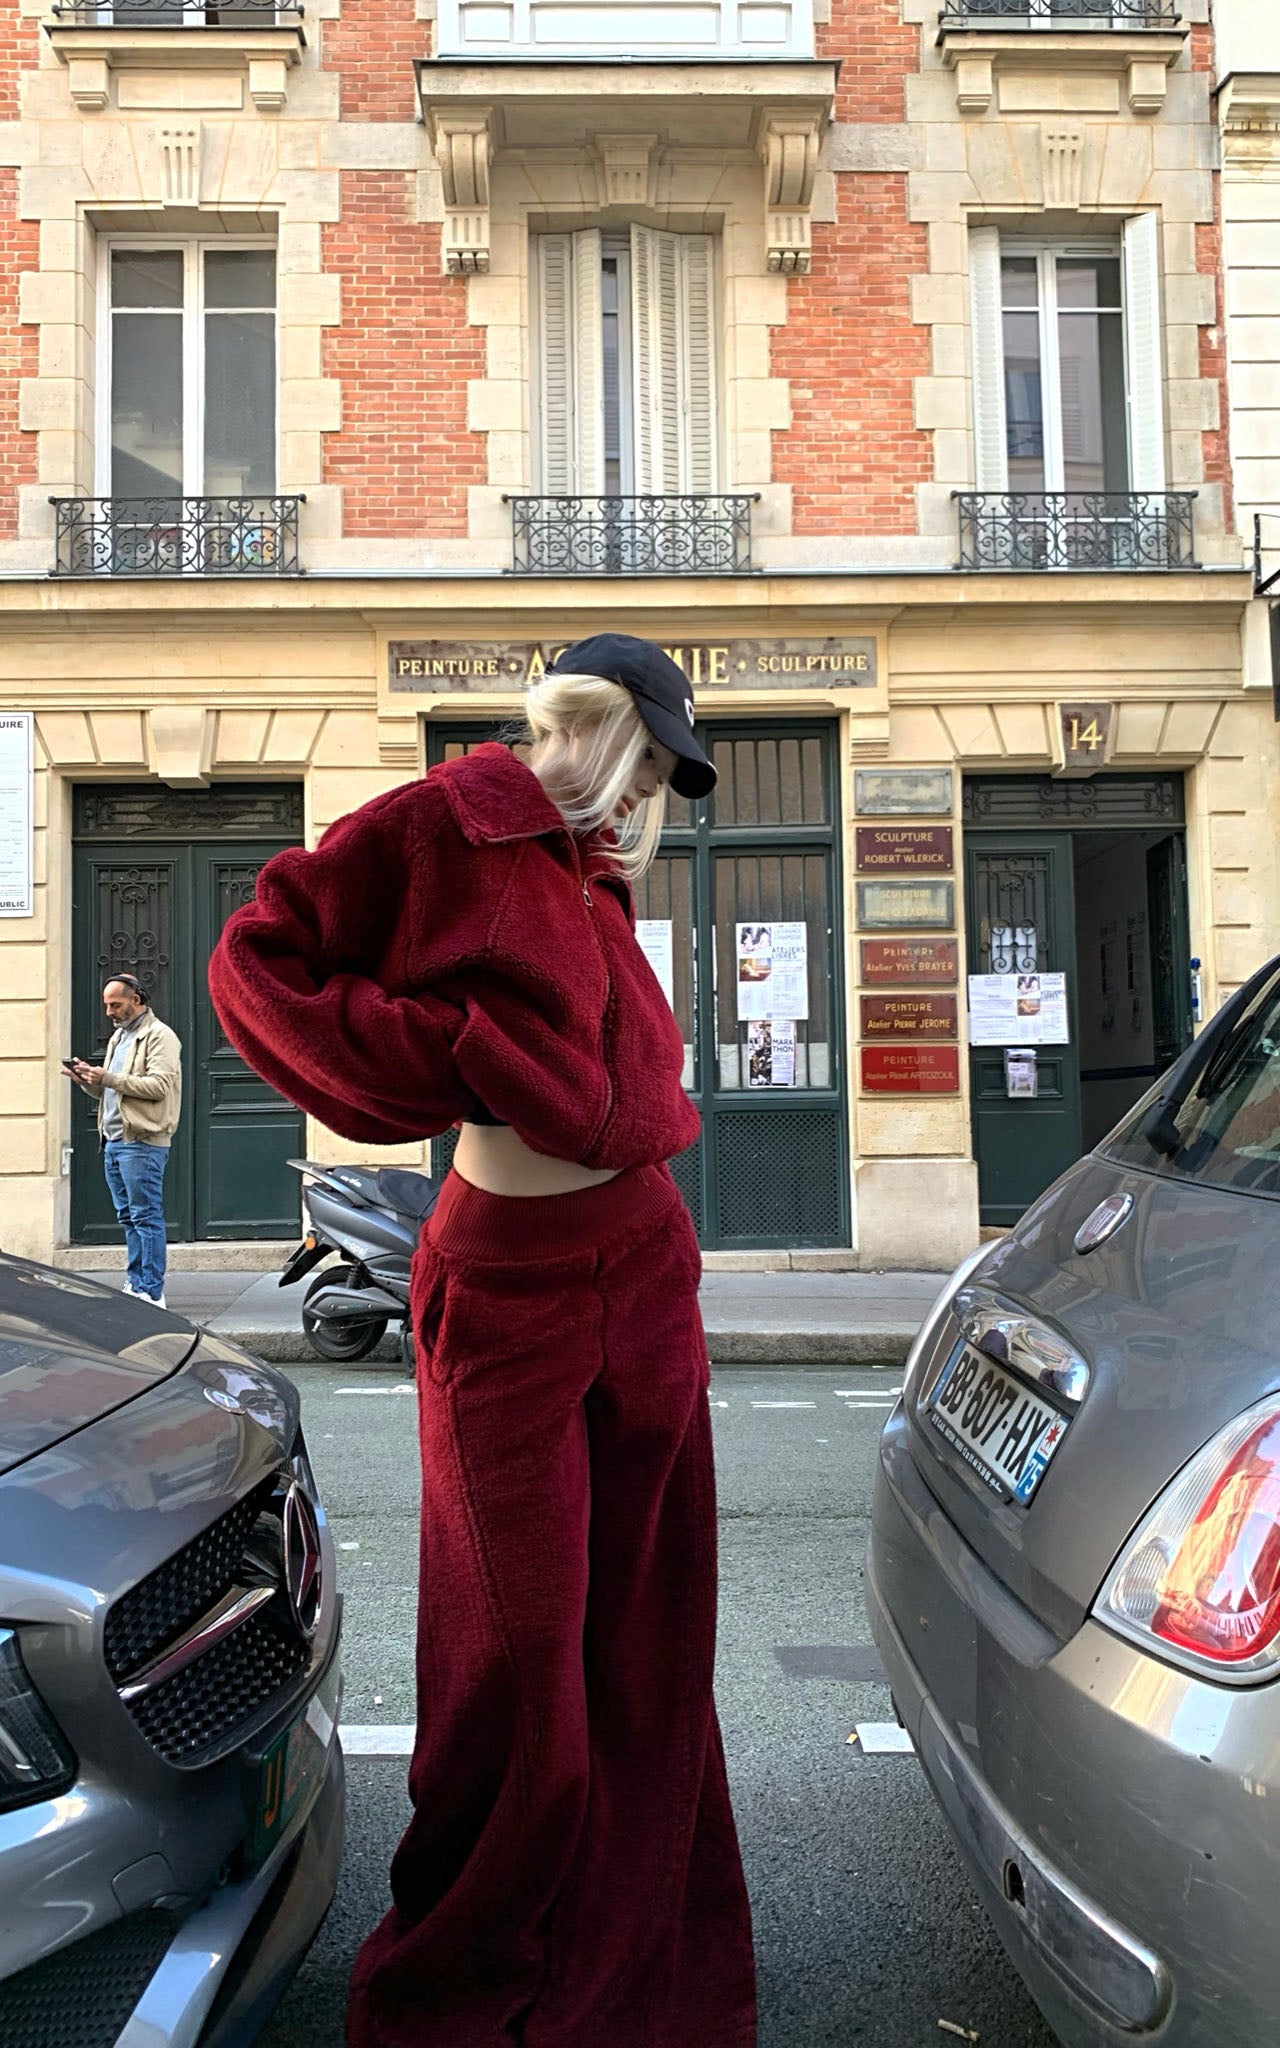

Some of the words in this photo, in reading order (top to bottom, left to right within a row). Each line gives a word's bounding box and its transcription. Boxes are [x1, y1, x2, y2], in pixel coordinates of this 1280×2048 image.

[399, 659, 498, 676] PEINTURE
[757, 655, 867, 672] SCULPTURE
[1070, 718, 1102, 750] 14
[874, 832, 934, 843] SCULPTURE
[864, 854, 900, 864] ROBERT
[903, 853, 944, 863] WLERICK
[866, 963, 893, 972] Atelier
[884, 1003, 933, 1012] PEINTURE
[867, 1020, 891, 1029] Atelier
[883, 1055, 935, 1065] PEINTURE
[939, 1350, 1051, 1481] BB-607-HX
[1018, 1458, 1043, 1496] 75
